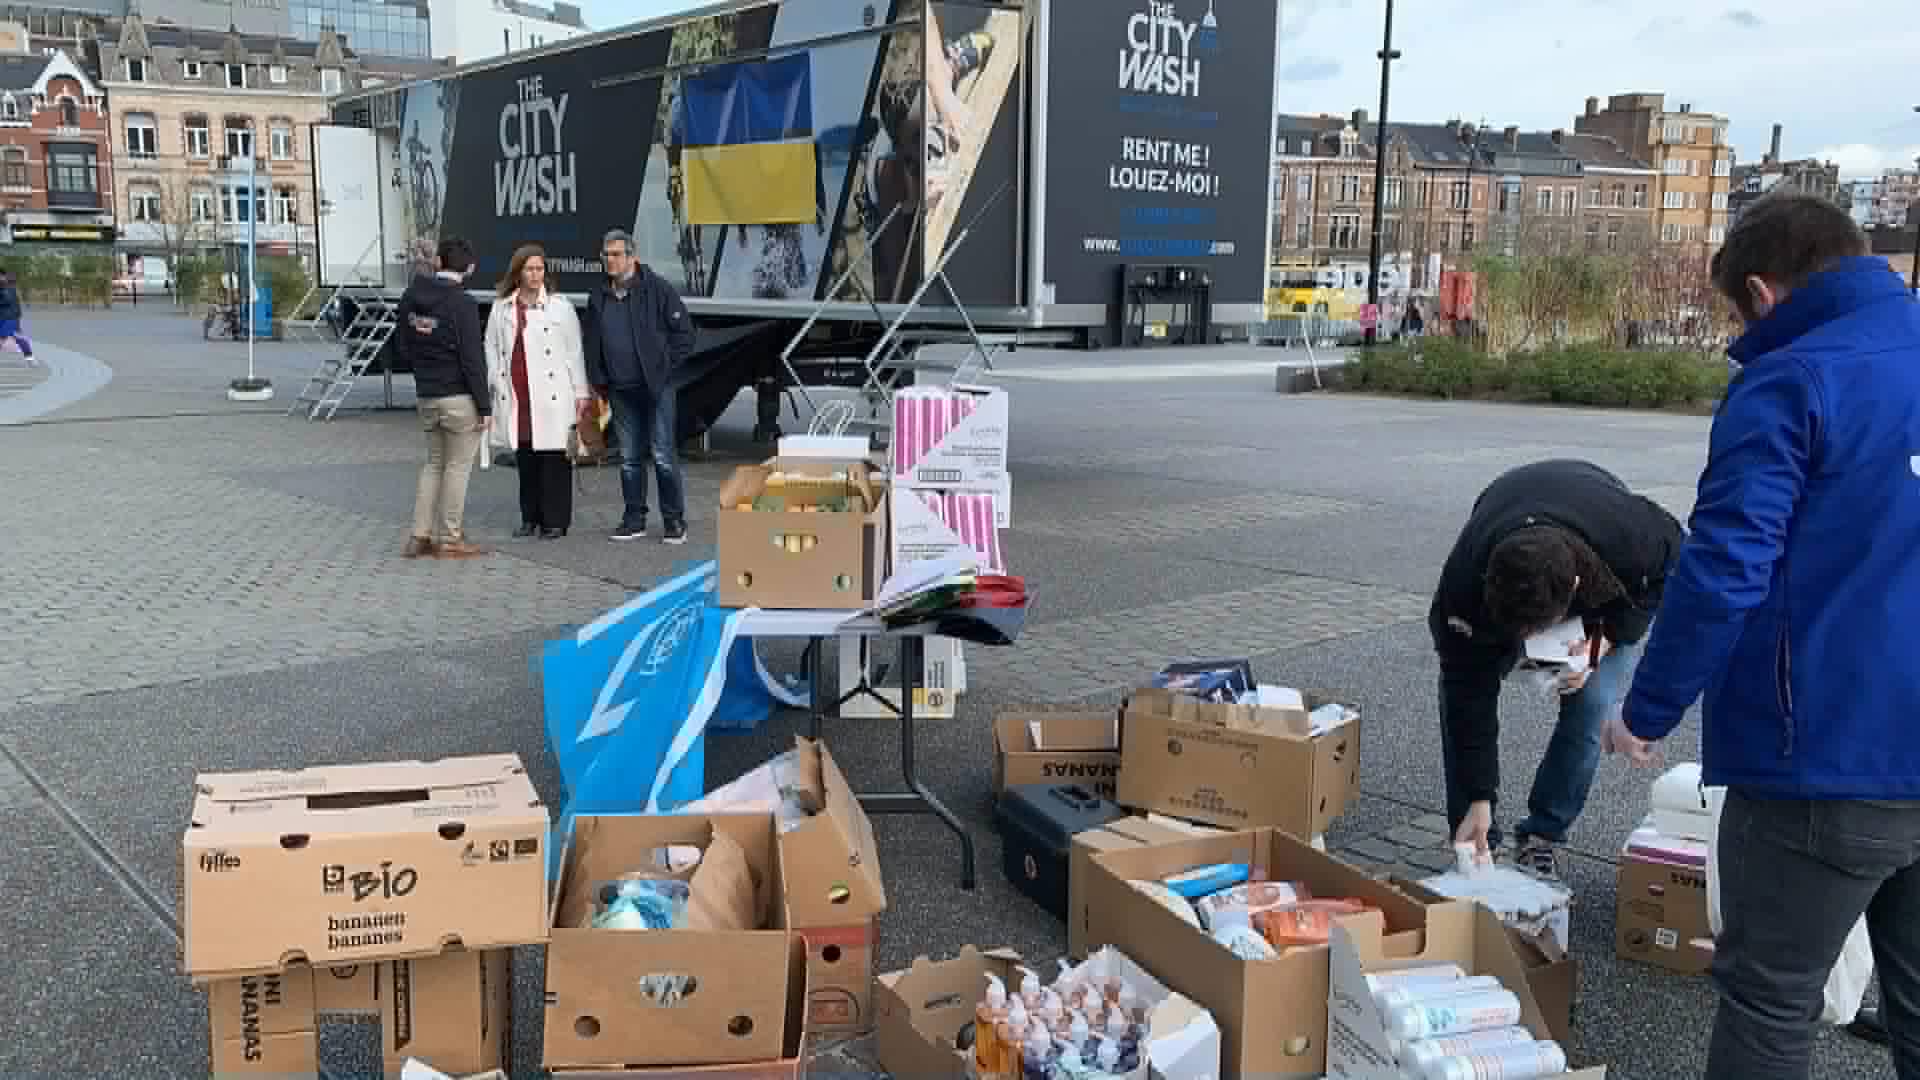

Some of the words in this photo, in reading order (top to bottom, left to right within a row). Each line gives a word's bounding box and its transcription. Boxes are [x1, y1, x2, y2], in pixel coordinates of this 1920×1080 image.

[1149, 0, 1176, 18] THE
[1127, 13, 1198, 56] CITY
[516, 75, 544, 100] THE
[1119, 49, 1200, 96] WASH
[500, 92, 569, 159] CITY
[1122, 136, 1169, 162] RENT
[495, 151, 577, 216] WASH
